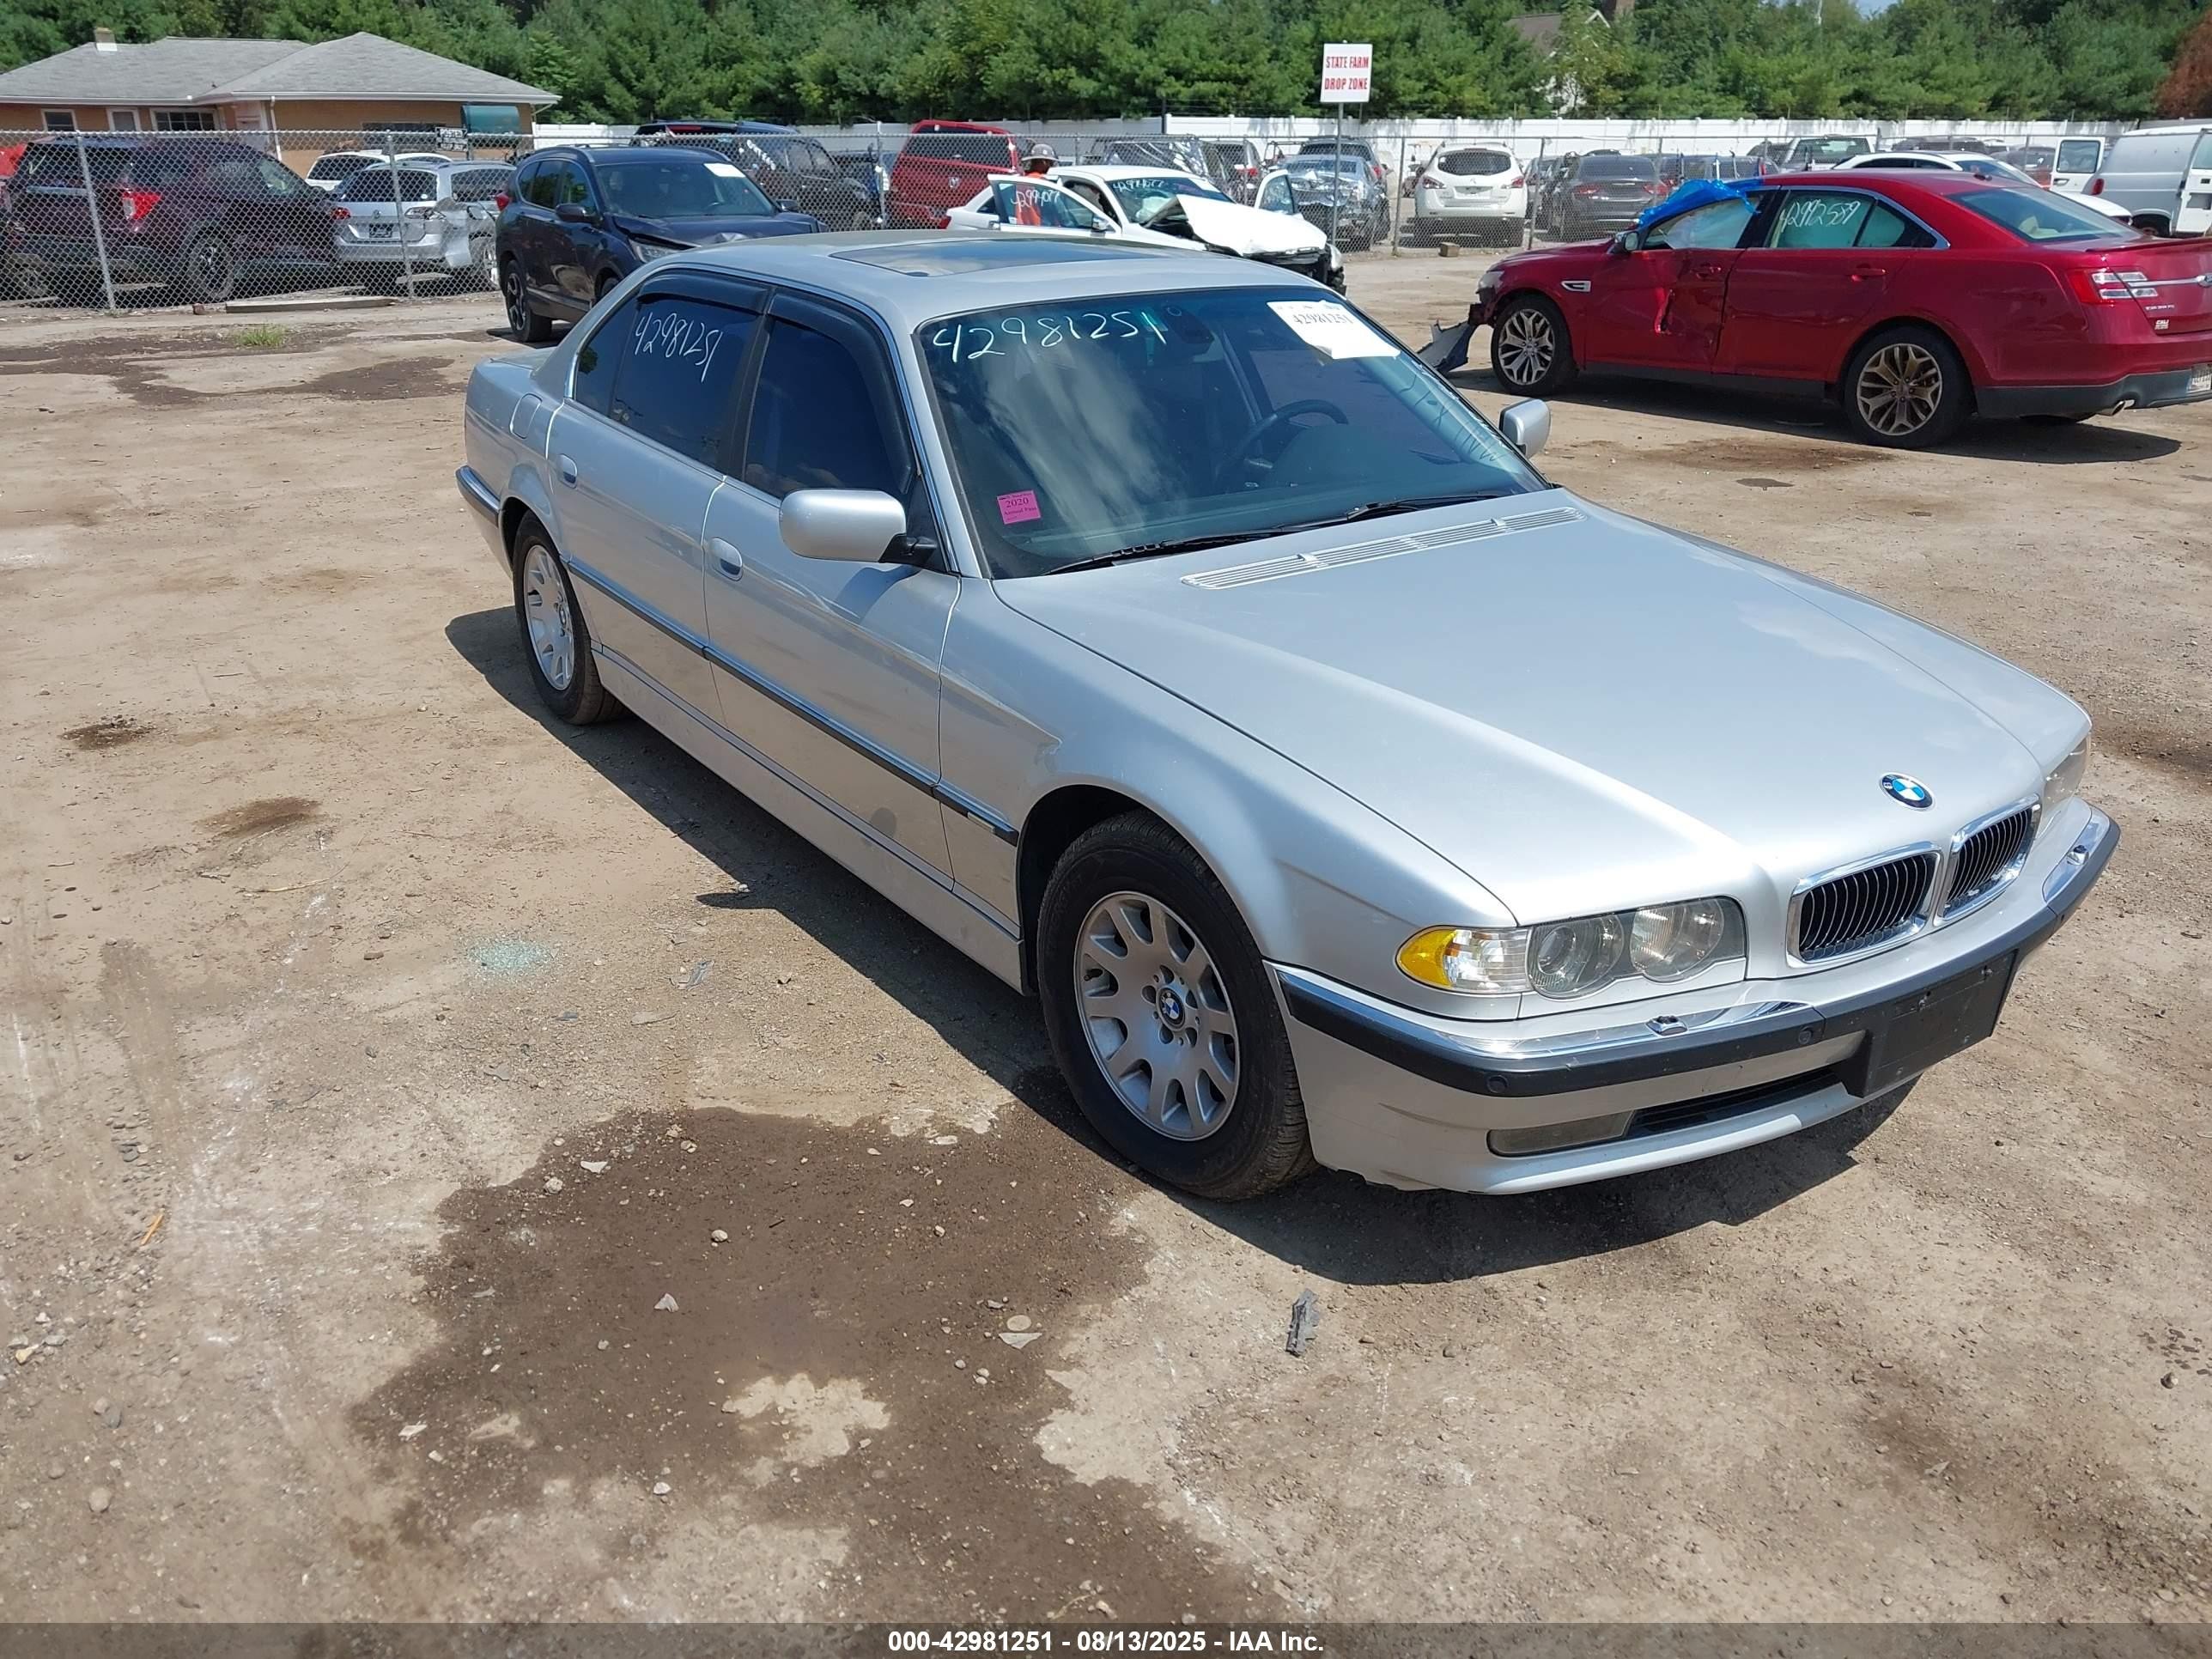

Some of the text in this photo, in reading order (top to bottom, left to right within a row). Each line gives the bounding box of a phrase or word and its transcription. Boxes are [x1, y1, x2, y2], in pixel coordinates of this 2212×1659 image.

[1326, 56, 1369, 69] STATE FARM
[1324, 78, 1368, 90] DROP ZONE
[933, 311, 1167, 363] 42981251
[635, 312, 723, 383] 42981251
[1005, 497, 1030, 508] 2020
